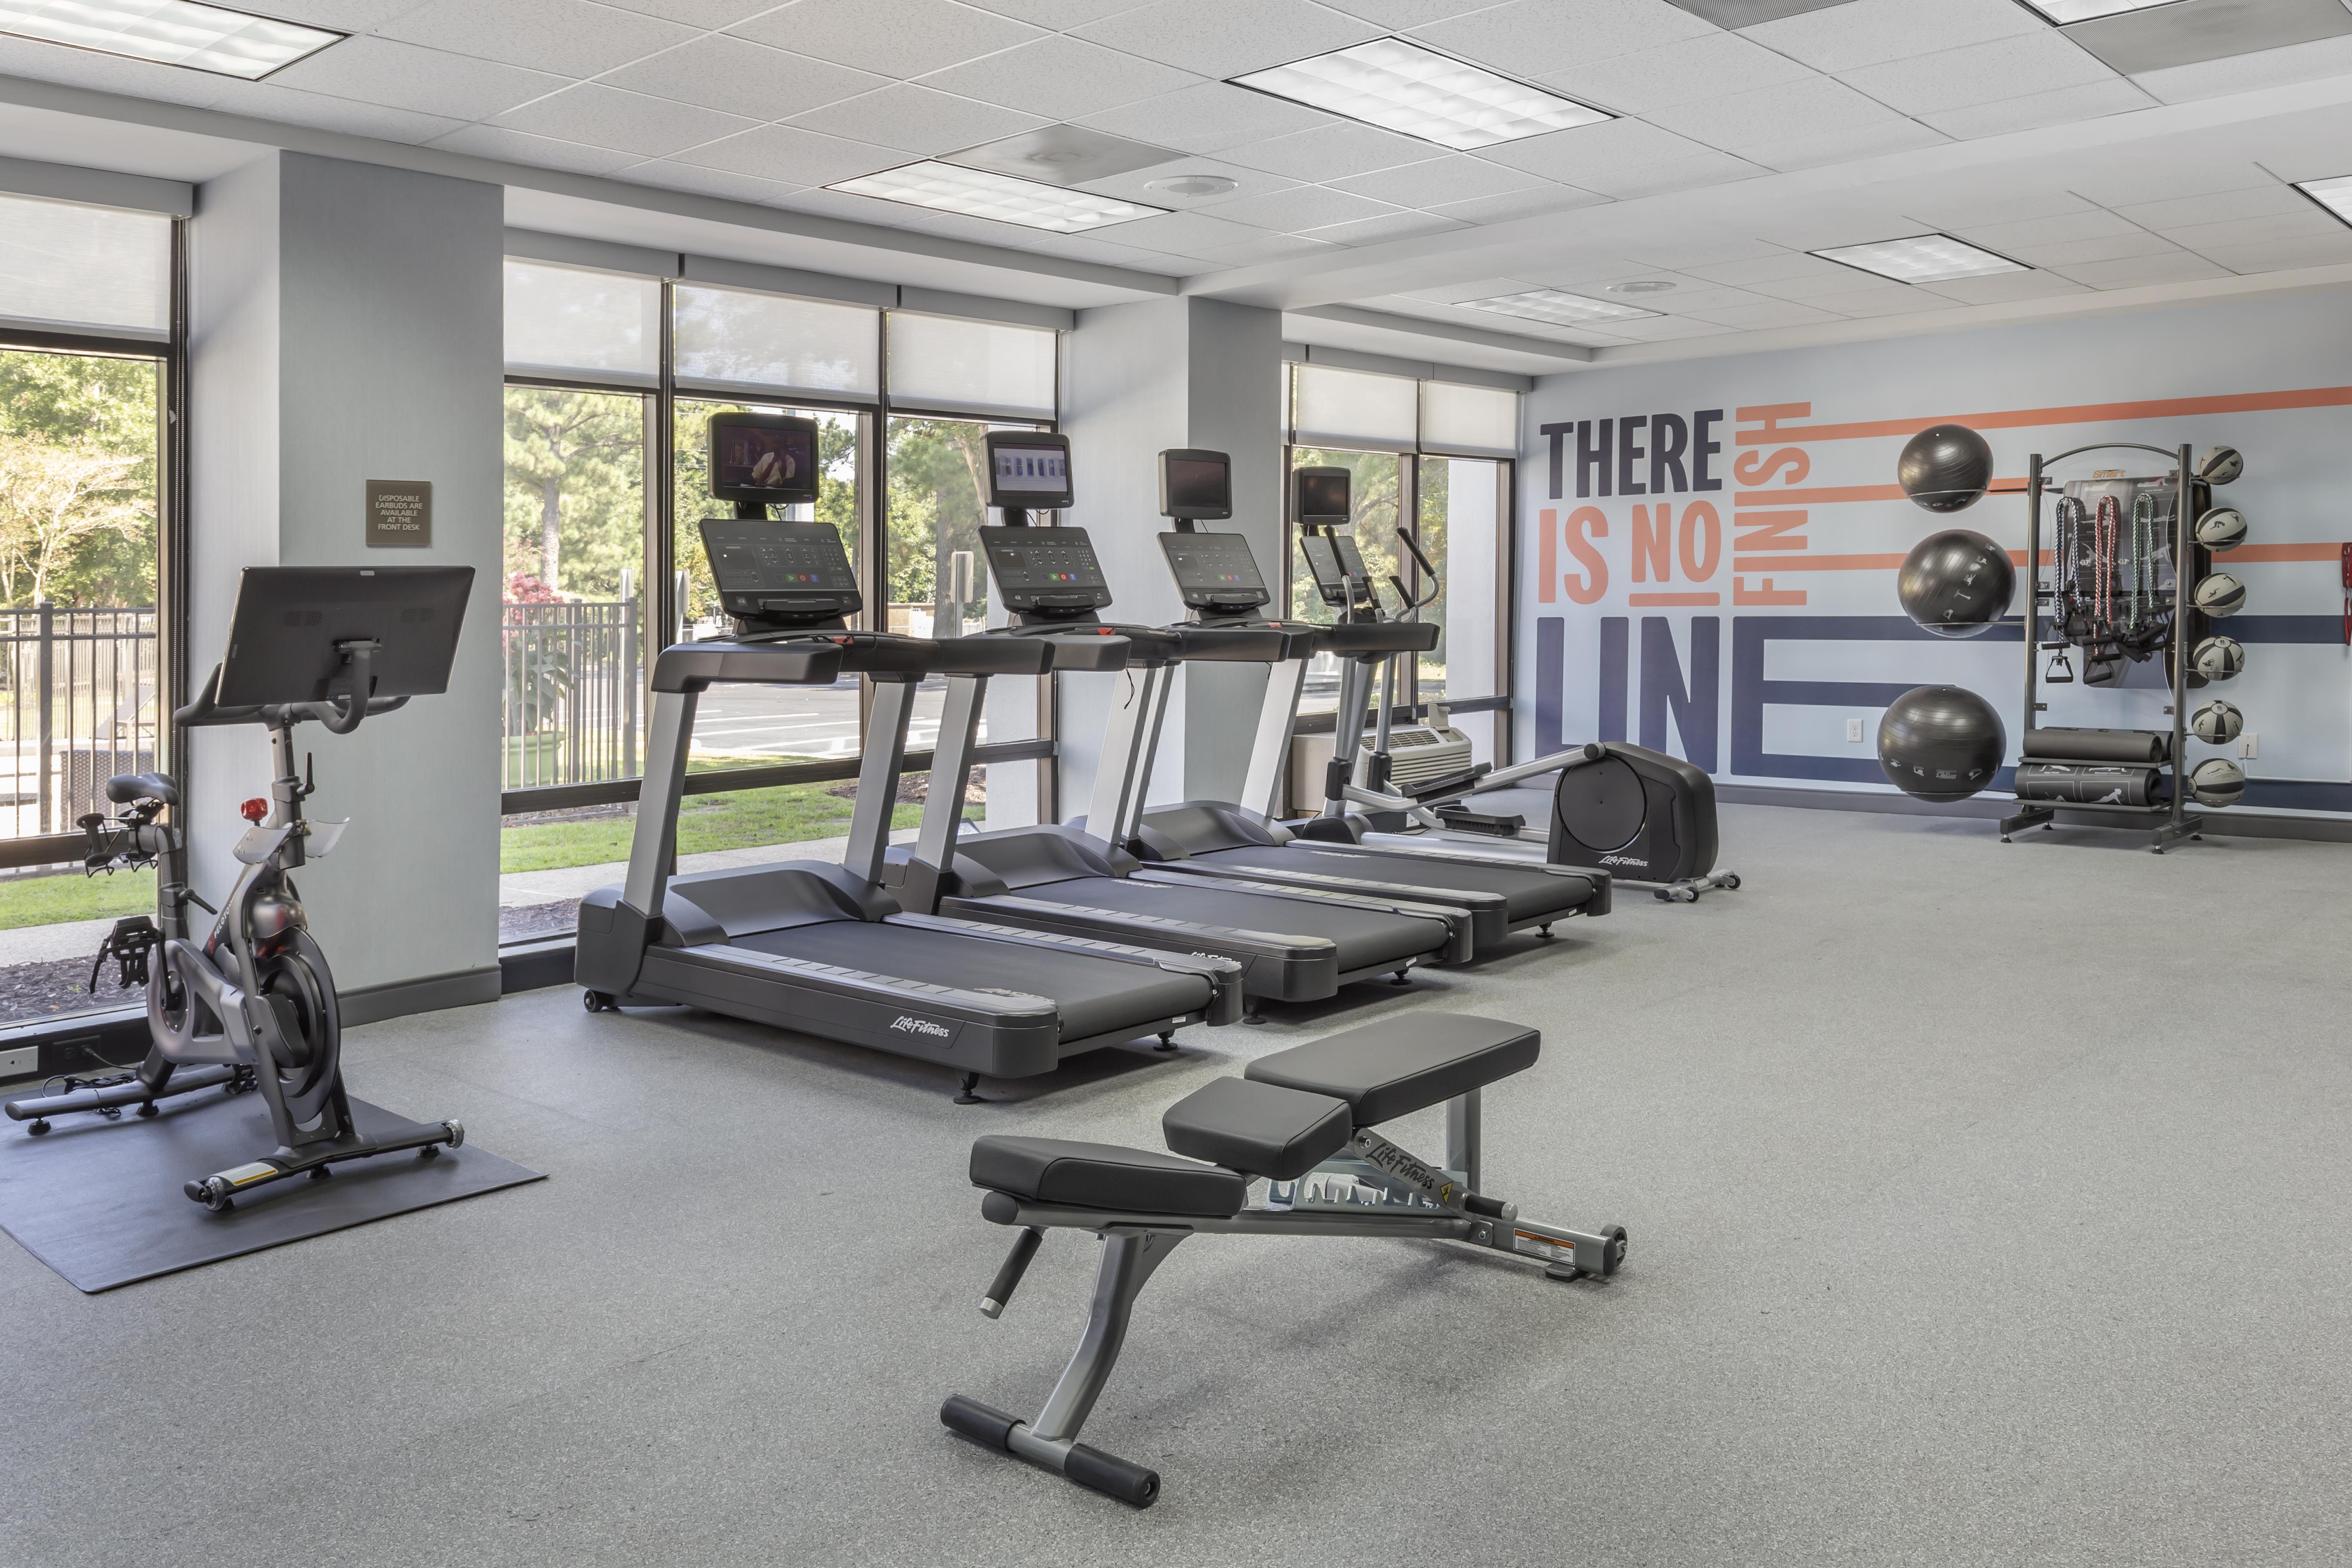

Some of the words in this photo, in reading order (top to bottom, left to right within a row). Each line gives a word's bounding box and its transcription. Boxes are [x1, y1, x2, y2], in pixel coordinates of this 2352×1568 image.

[1540, 409, 1724, 499] THERE
[1733, 401, 1811, 606] FINISH
[1538, 506, 1609, 605] IS
[1632, 500, 1721, 582] NO
